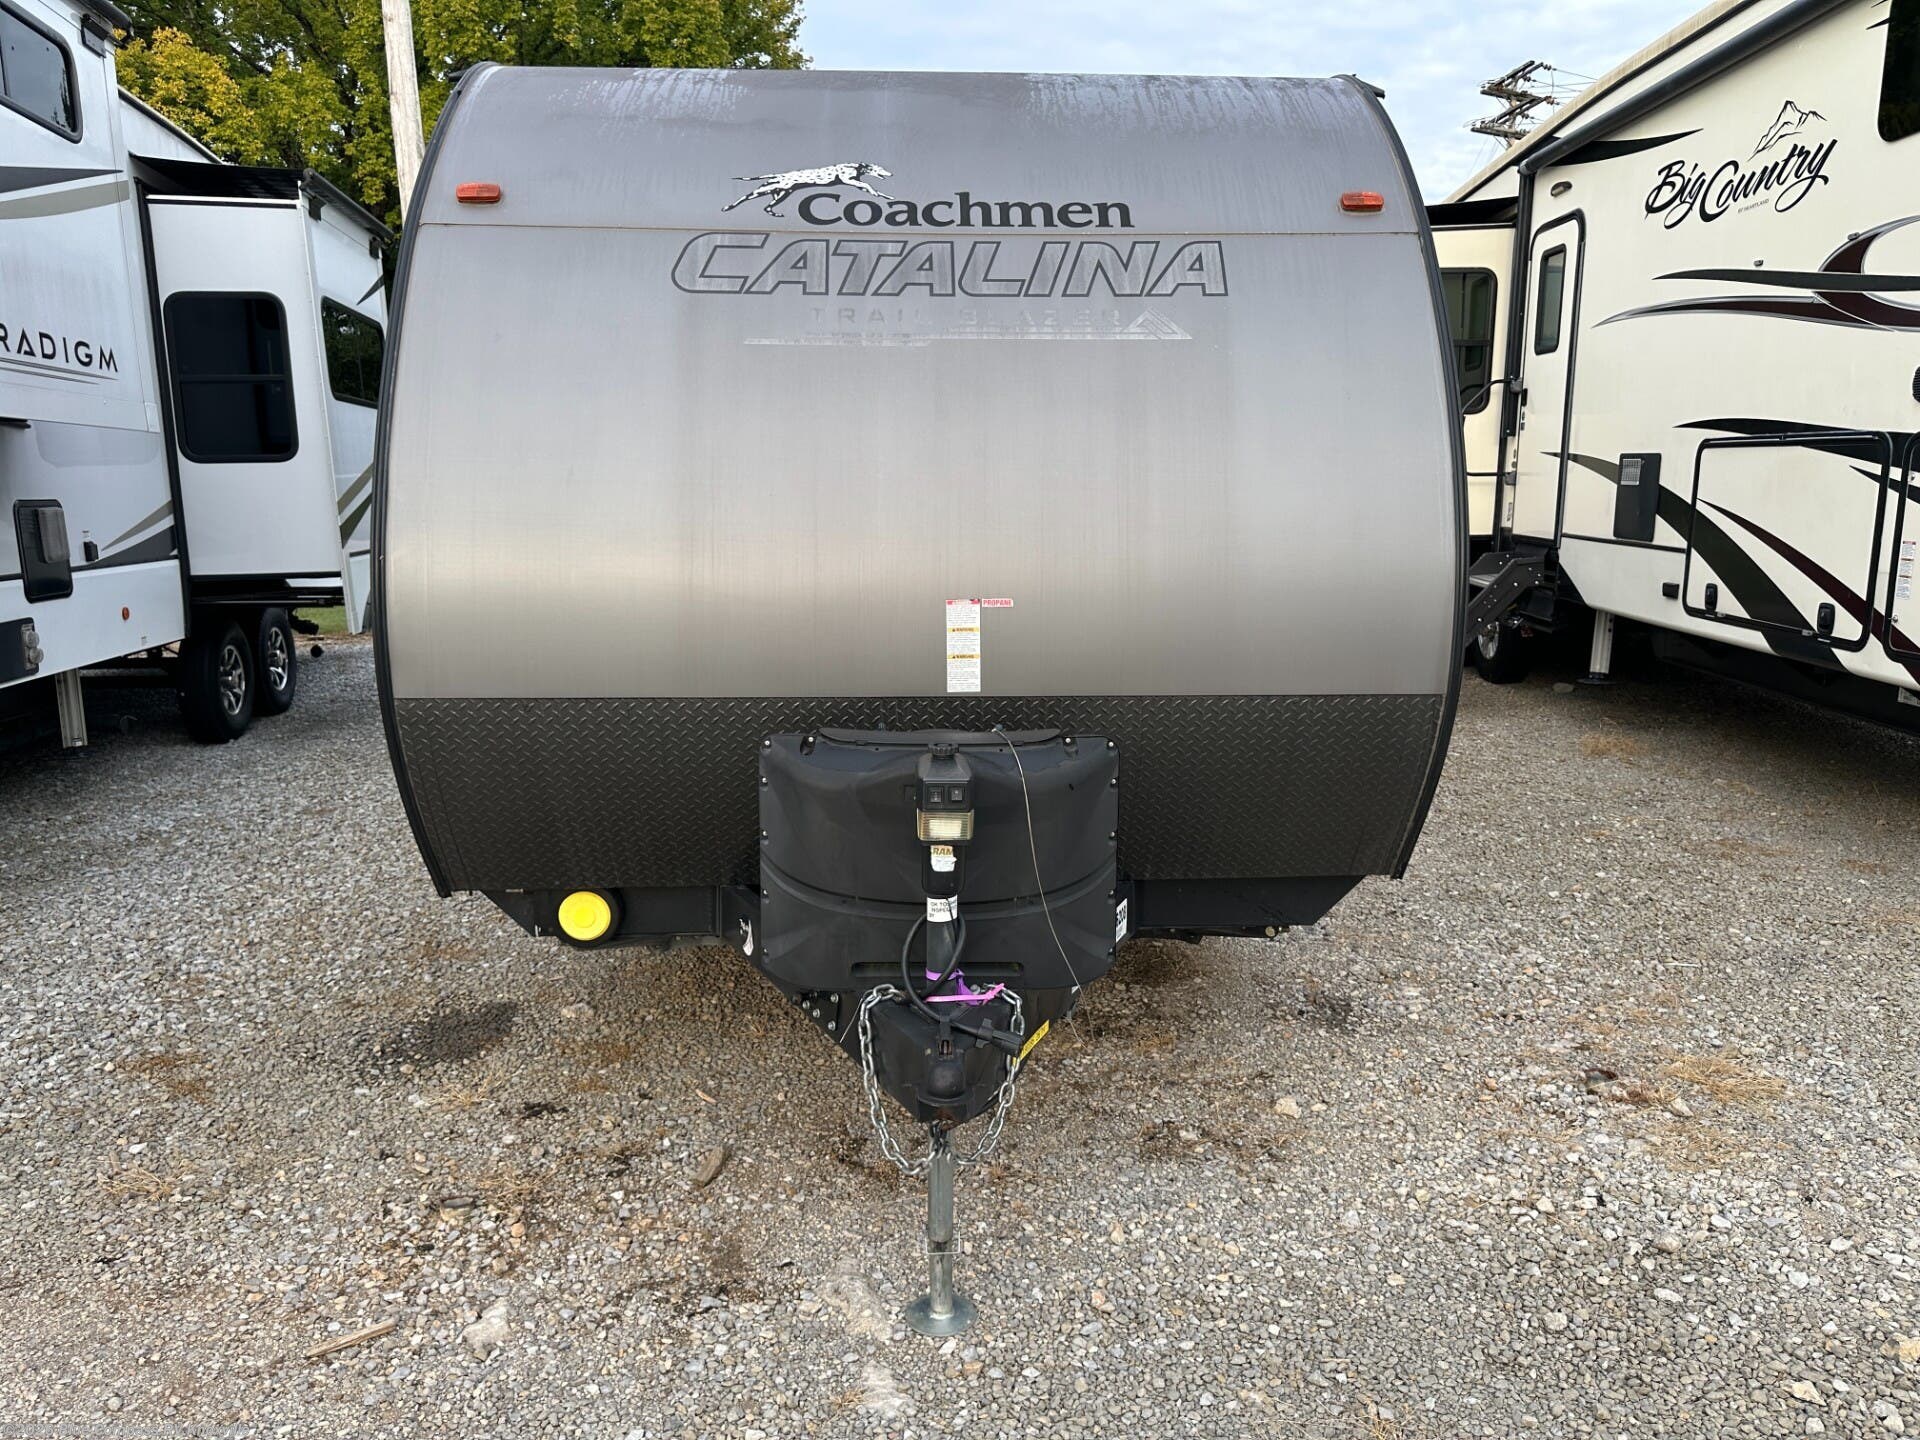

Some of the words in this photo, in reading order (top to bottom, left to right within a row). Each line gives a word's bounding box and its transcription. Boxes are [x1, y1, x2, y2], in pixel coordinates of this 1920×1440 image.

[799, 191, 1136, 228] Coachmen
[1645, 160, 1706, 229] Big
[1700, 139, 1838, 223] Country
[670, 231, 1229, 298] CATALINA
[811, 307, 932, 325] TRAIL
